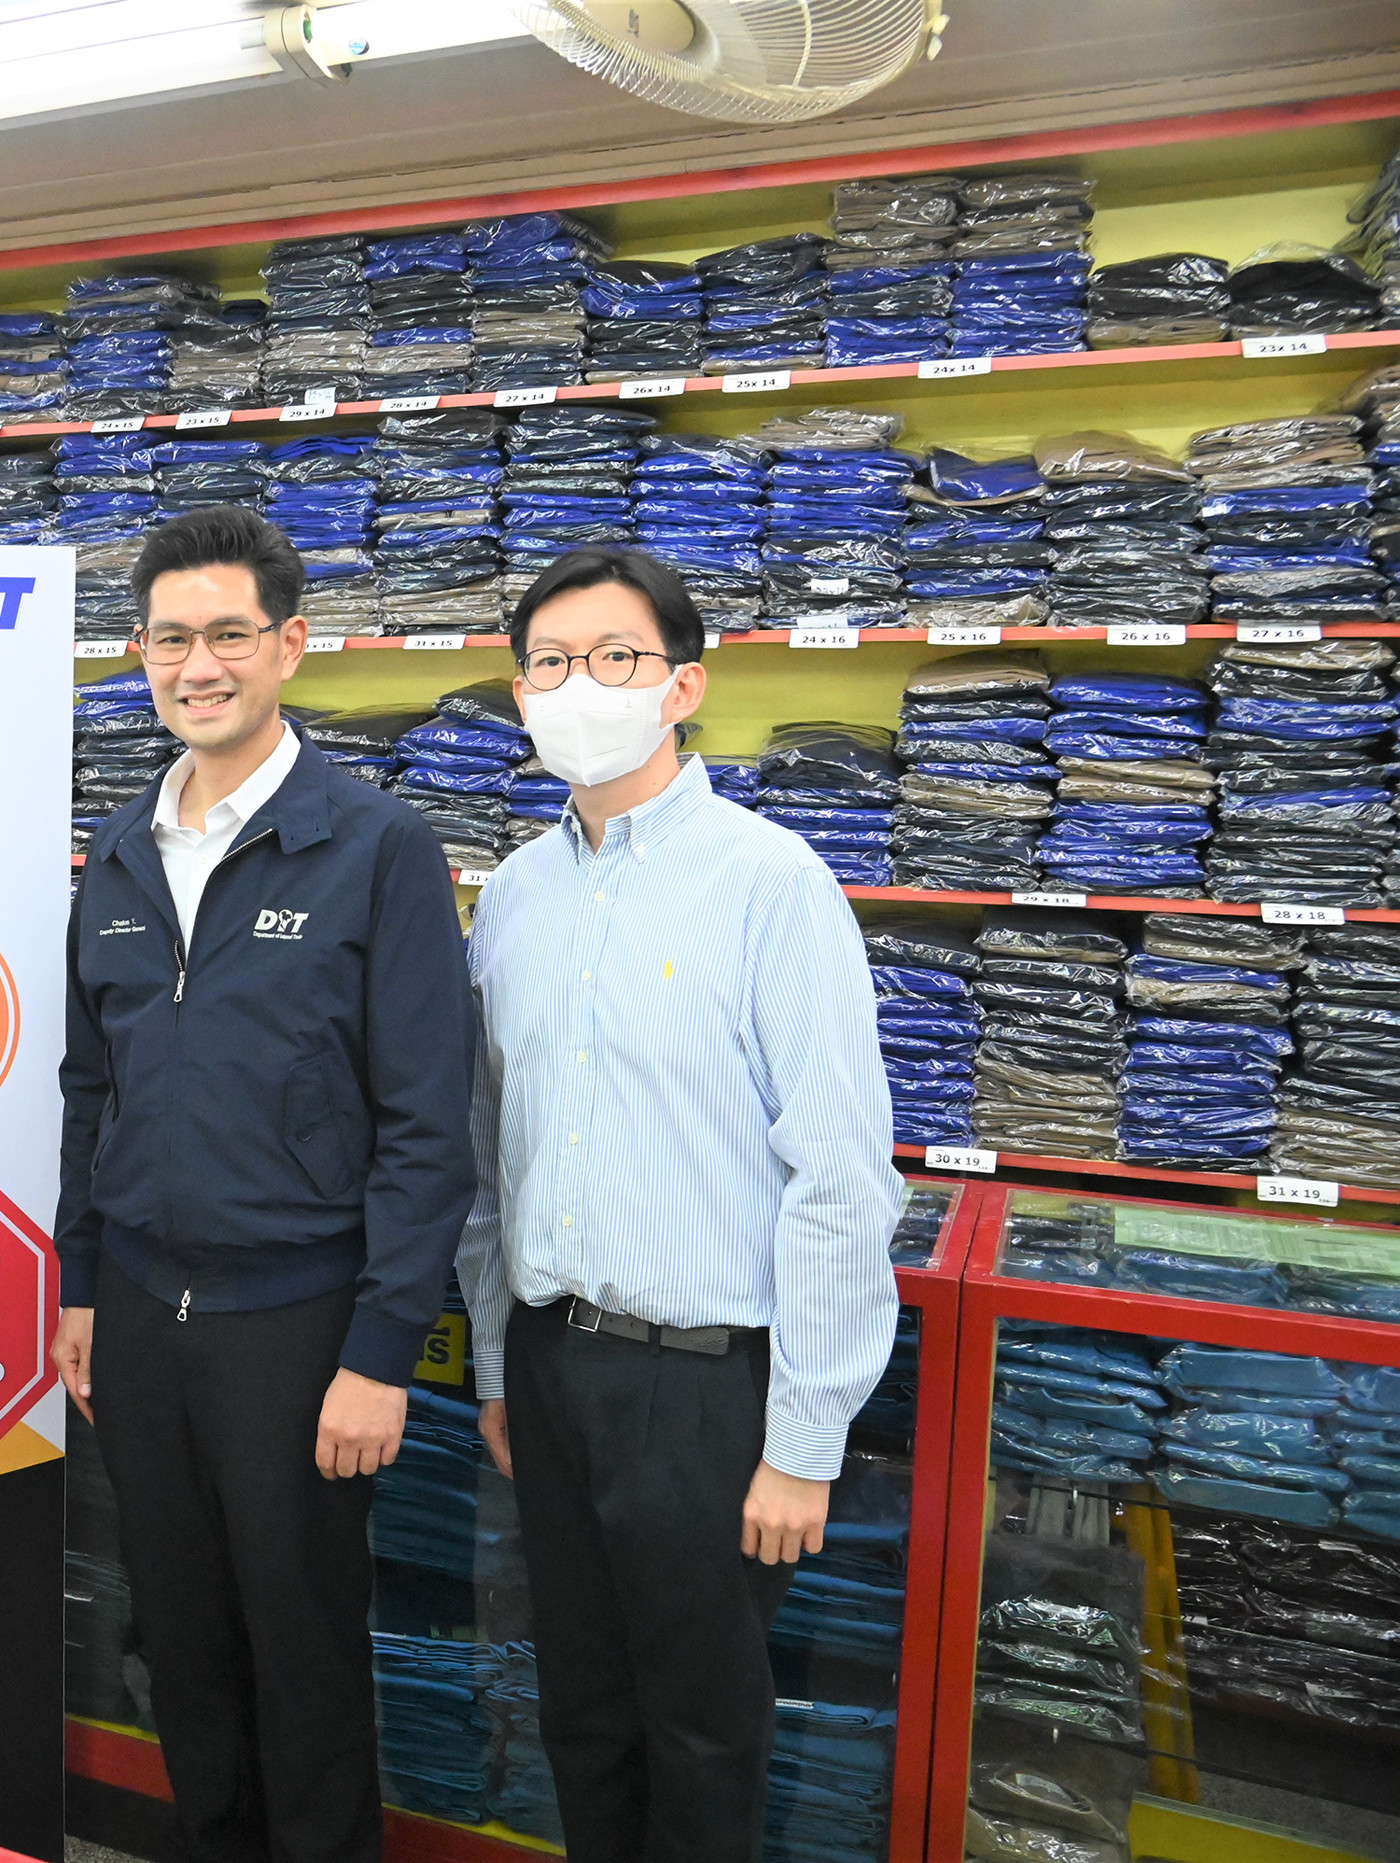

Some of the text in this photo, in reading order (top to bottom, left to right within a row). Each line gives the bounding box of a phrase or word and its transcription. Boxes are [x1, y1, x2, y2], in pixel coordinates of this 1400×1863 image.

[209, 416, 220, 424] 15
[1121, 632, 1137, 641] 26
[1155, 632, 1170, 641] 16
[1252, 630, 1269, 638] 27
[1288, 630, 1304, 638] 16
[802, 635, 816, 644] 24
[831, 635, 846, 644] 16
[106, 646, 116, 654] 15
[1274, 910, 1291, 919] 28
[1309, 911, 1326, 920] 18
[254, 909, 309, 933] DIT
[935, 1153, 950, 1164] 30
[965, 1157, 980, 1166] 19
[1268, 1186, 1286, 1196] 31
[1304, 1189, 1320, 1199] 19
